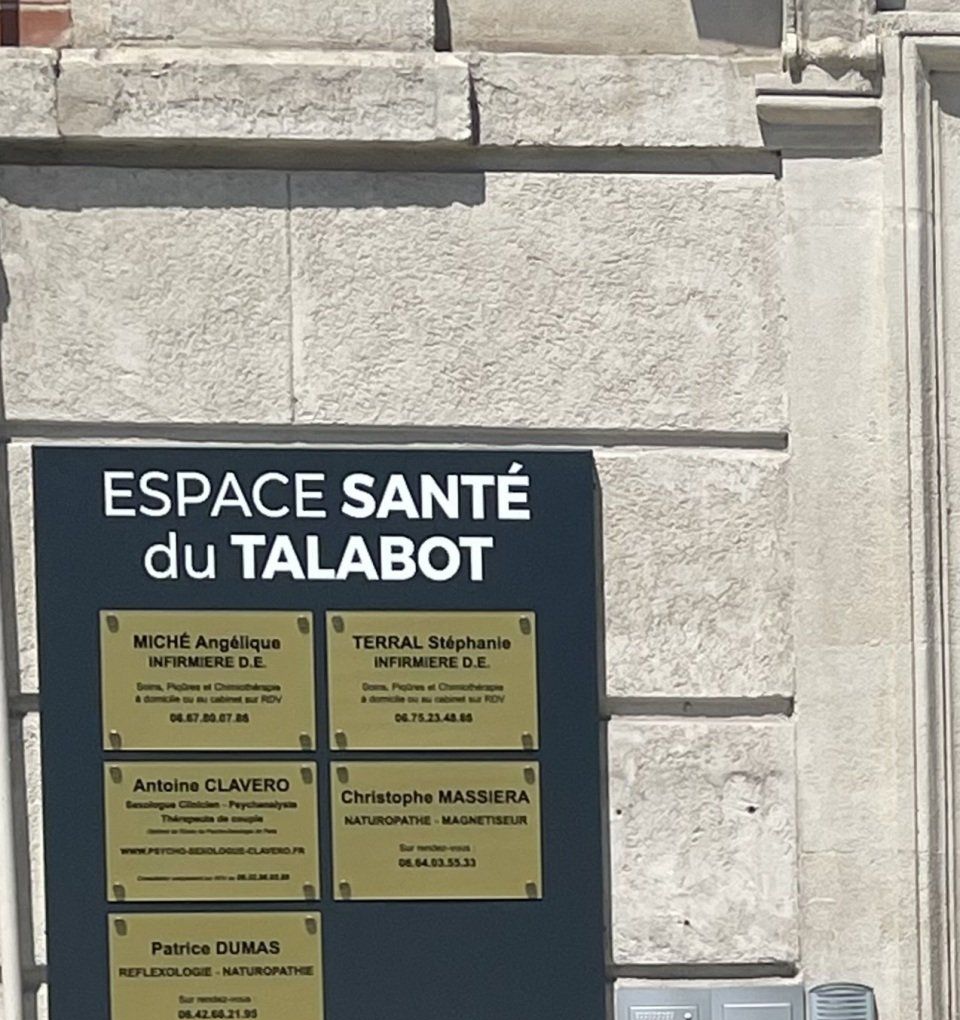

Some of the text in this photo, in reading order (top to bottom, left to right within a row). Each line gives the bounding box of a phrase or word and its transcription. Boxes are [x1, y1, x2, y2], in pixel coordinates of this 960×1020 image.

[102, 463, 531, 521] ESPACE SANTÉ
[143, 532, 493, 581] du TALABOT
[133, 632, 281, 653] MICHÉ Angélique
[352, 635, 511, 653] TERRAL Stéphanie
[149, 656, 267, 668] INFIRMIERE D.E.
[374, 656, 490, 668] INFIRMIERE D.E.
[133, 778, 290, 793] Antoine CLAVERO
[126, 800, 176, 811] Sexologue
[341, 790, 530, 807] Christophe MASSIERA
[161, 814, 215, 824] Thérapeute
[217, 815, 229, 823] de
[344, 815, 431, 826] NATUROPATHE
[441, 815, 528, 826] MAGNETISEUR
[151, 941, 281, 956] Patrice DUMAS
[119, 967, 212, 977] REFLEXOLOGIE
[223, 965, 314, 976] NATUROPATHIE
